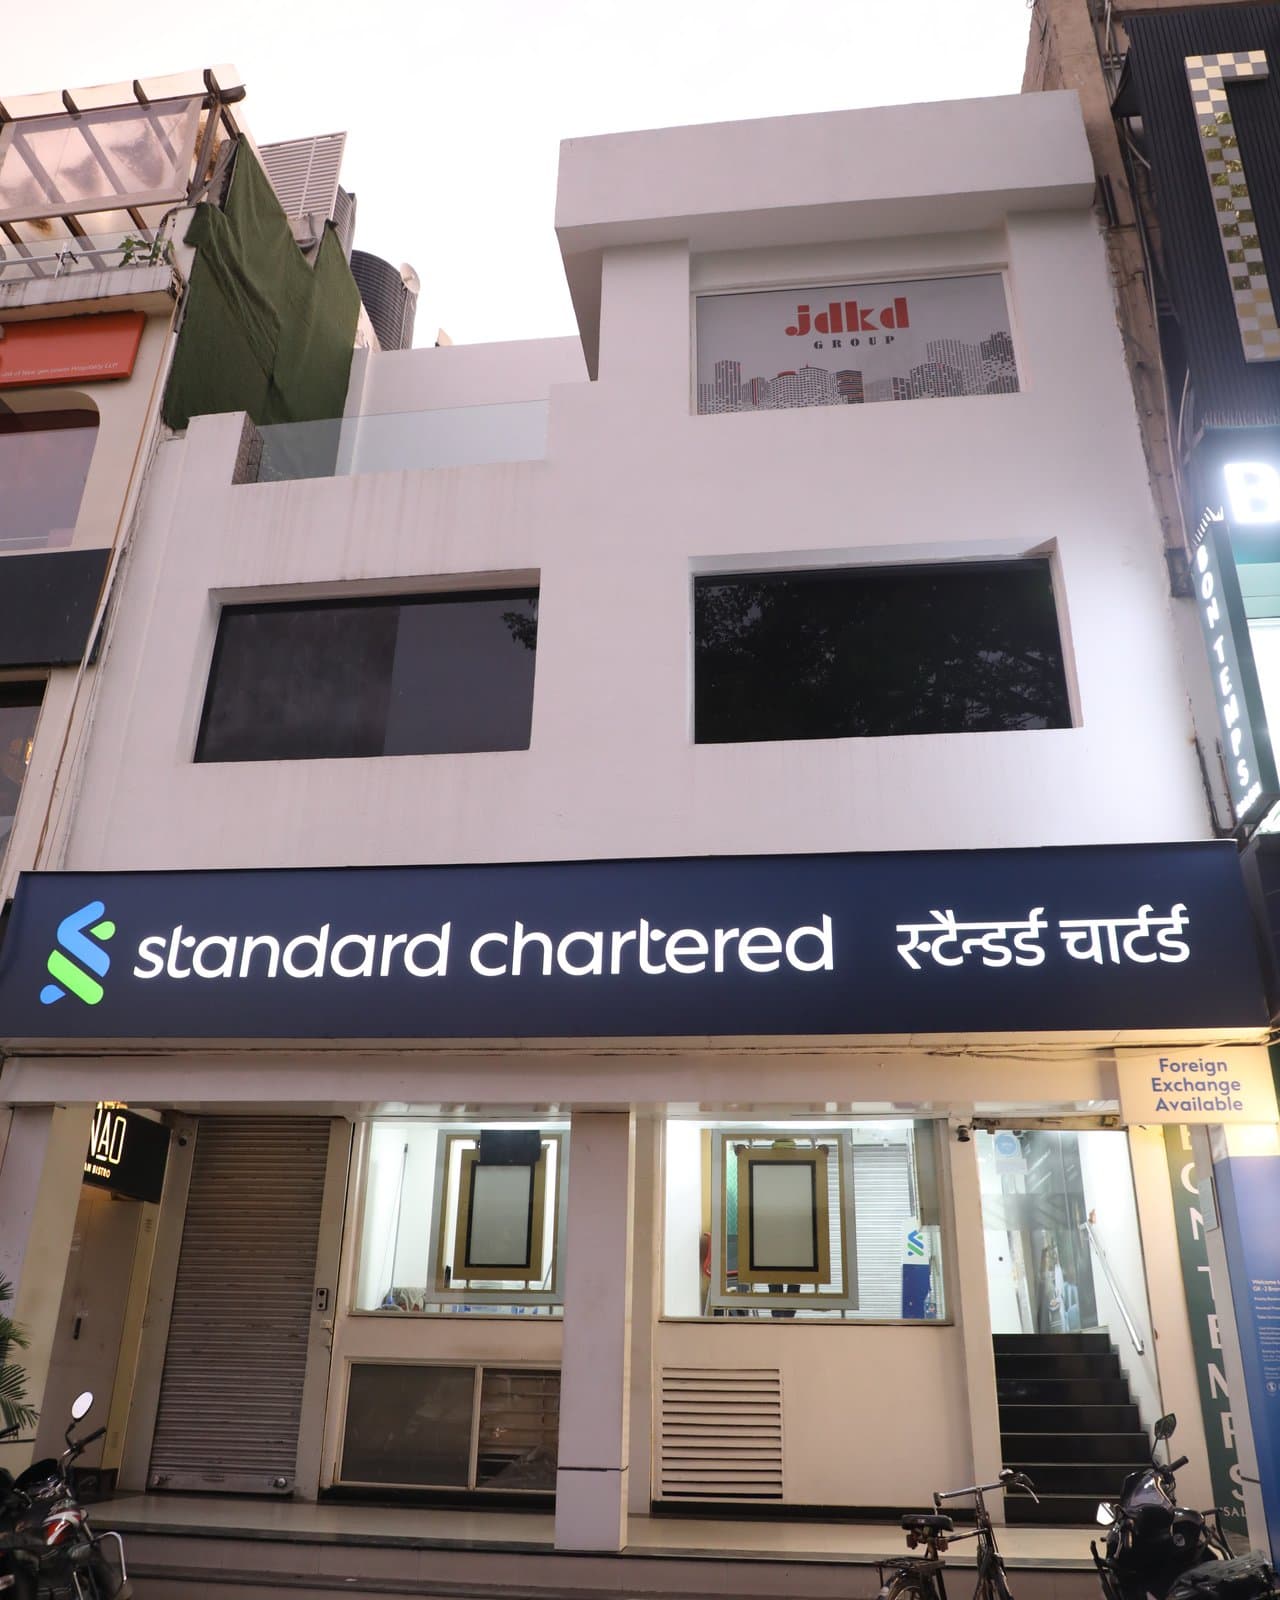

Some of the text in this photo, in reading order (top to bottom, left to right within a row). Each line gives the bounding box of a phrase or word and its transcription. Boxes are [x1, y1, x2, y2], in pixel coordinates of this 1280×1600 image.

[785, 297, 910, 336] jdkd
[813, 335, 895, 350] GROUP
[133, 913, 834, 979] standard chartered
[1159, 1058, 1228, 1076] Foreign
[1151, 1077, 1241, 1095] Exchange
[1155, 1096, 1244, 1112] Available
[92, 1165, 111, 1179] BISTRO
